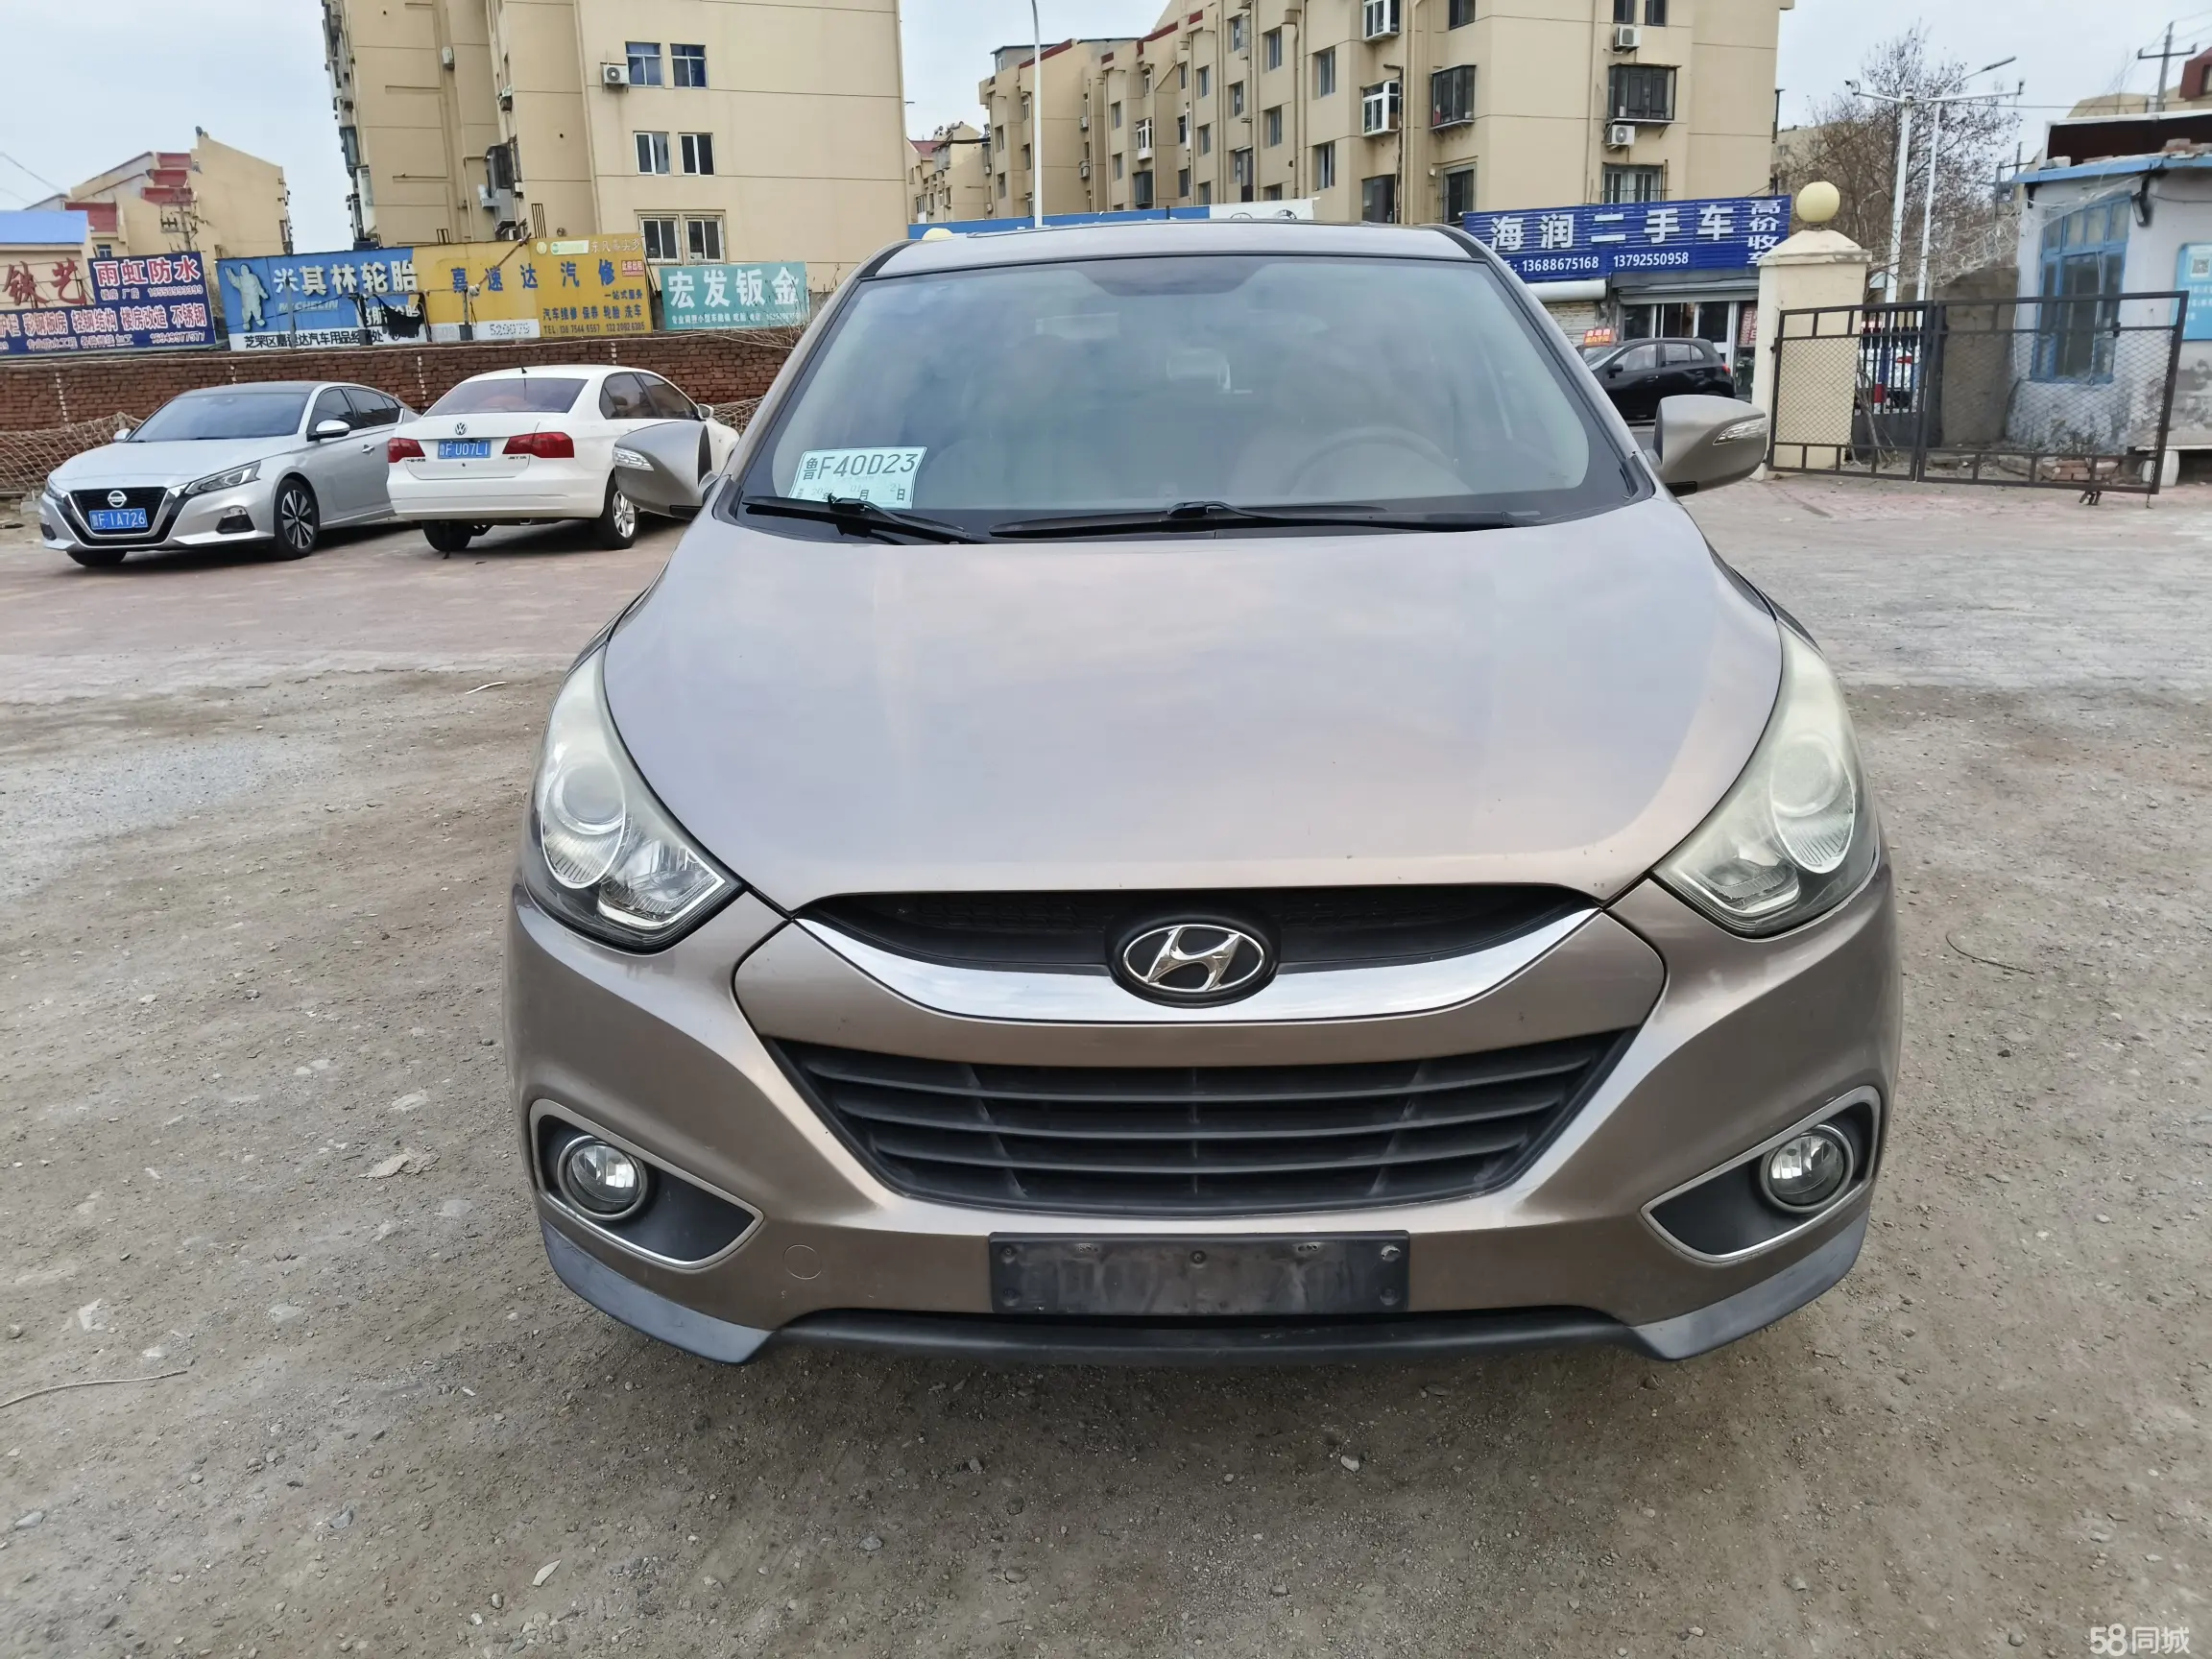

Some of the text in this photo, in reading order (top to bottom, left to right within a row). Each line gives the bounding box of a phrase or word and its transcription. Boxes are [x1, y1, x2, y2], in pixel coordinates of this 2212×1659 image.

[1490, 204, 1734, 252] 海润二手车
[93, 255, 201, 286] 雨虹防水
[450, 258, 615, 294] 嘉速达汽修
[1522, 255, 1599, 273] 13688675168
[1613, 251, 1690, 269] 13792550958
[2, 257, 87, 305] 铁艺
[273, 260, 418, 296] 米其林轮胎
[667, 266, 800, 309] 宏发钣金
[120, 303, 169, 330] 楼房改造
[170, 302, 207, 328] 不锈钢
[278, 299, 339, 312] MCHELIN
[542, 306, 578, 322] 汽车维修
[624, 303, 642, 319] 洗车
[803, 453, 919, 481] 鲁F40D23
